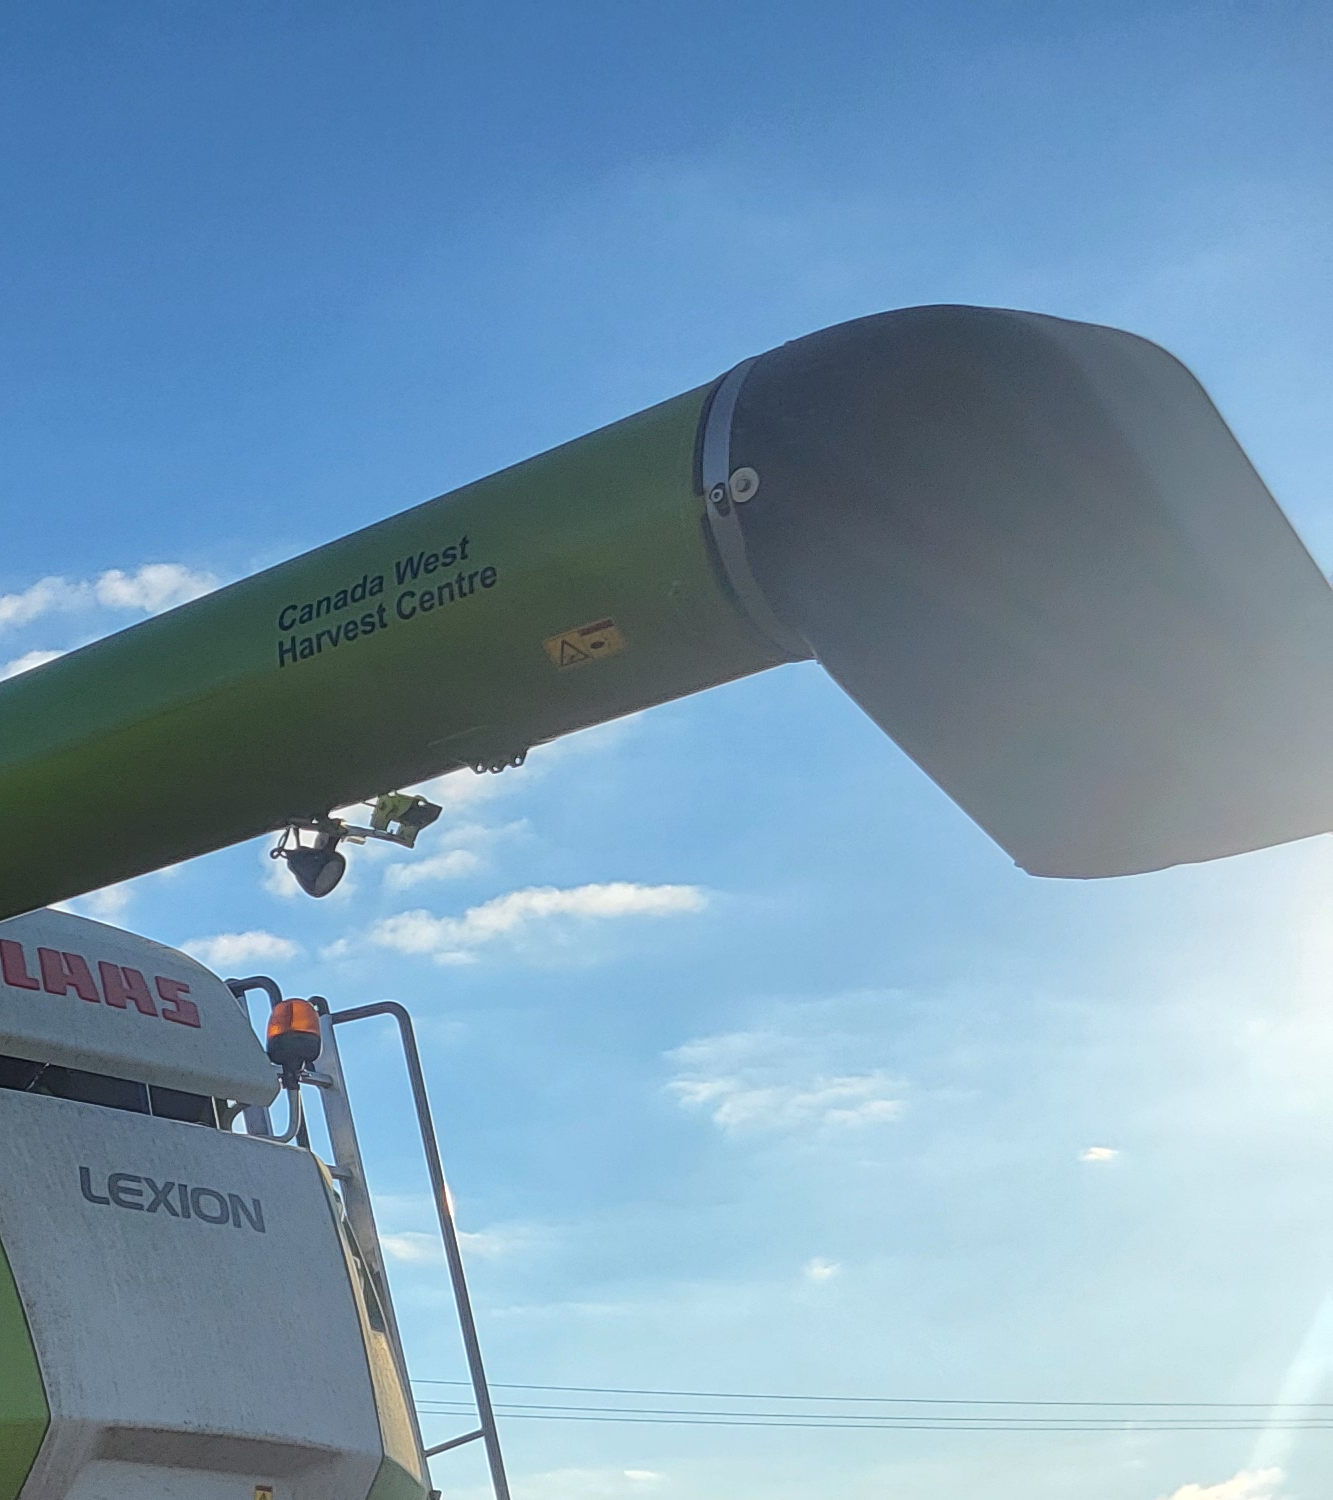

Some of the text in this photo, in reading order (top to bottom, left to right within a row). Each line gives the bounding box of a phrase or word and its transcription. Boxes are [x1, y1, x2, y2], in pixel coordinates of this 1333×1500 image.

[278, 535, 470, 631] Canada West
[278, 566, 497, 667] Harvest Centre
[79, 1165, 266, 1233] LEXION
